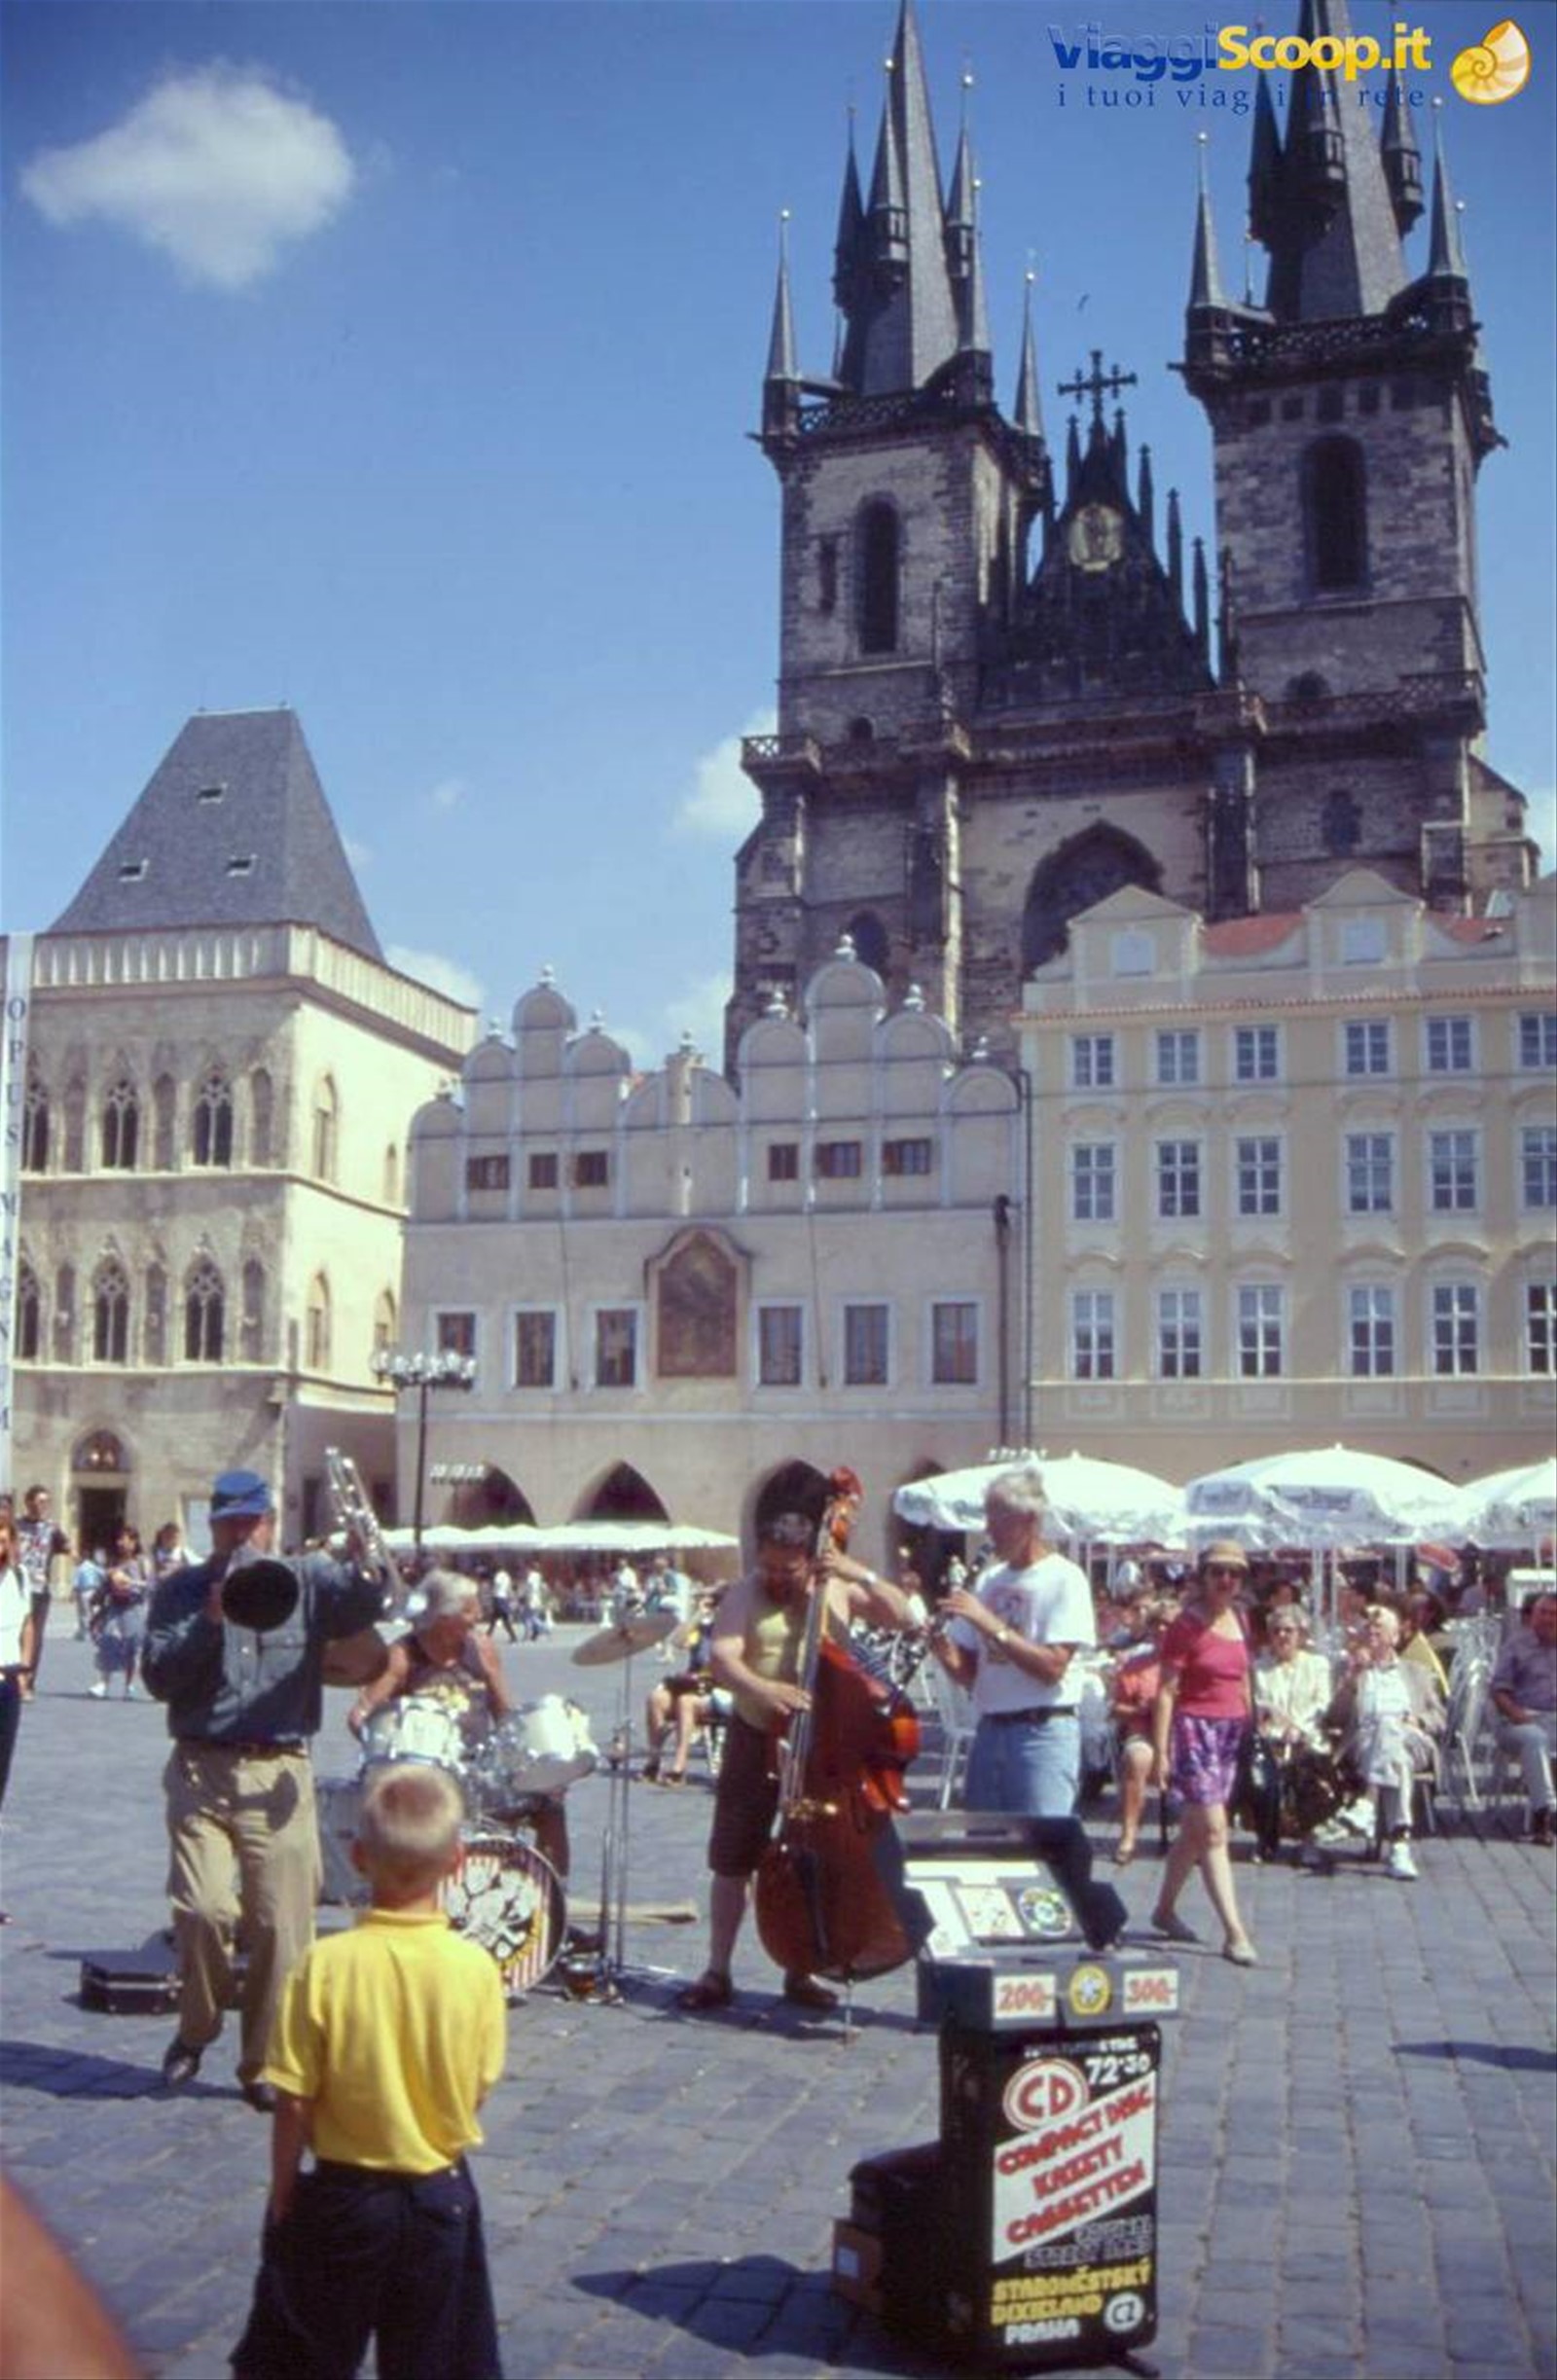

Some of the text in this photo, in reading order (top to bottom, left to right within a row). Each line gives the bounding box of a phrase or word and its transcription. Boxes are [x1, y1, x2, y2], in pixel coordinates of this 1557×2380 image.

[5, 996, 26, 1147] OPUS
[997, 2083, 1153, 2176] COMPACT DISC
[1018, 2073, 1075, 2118] CD
